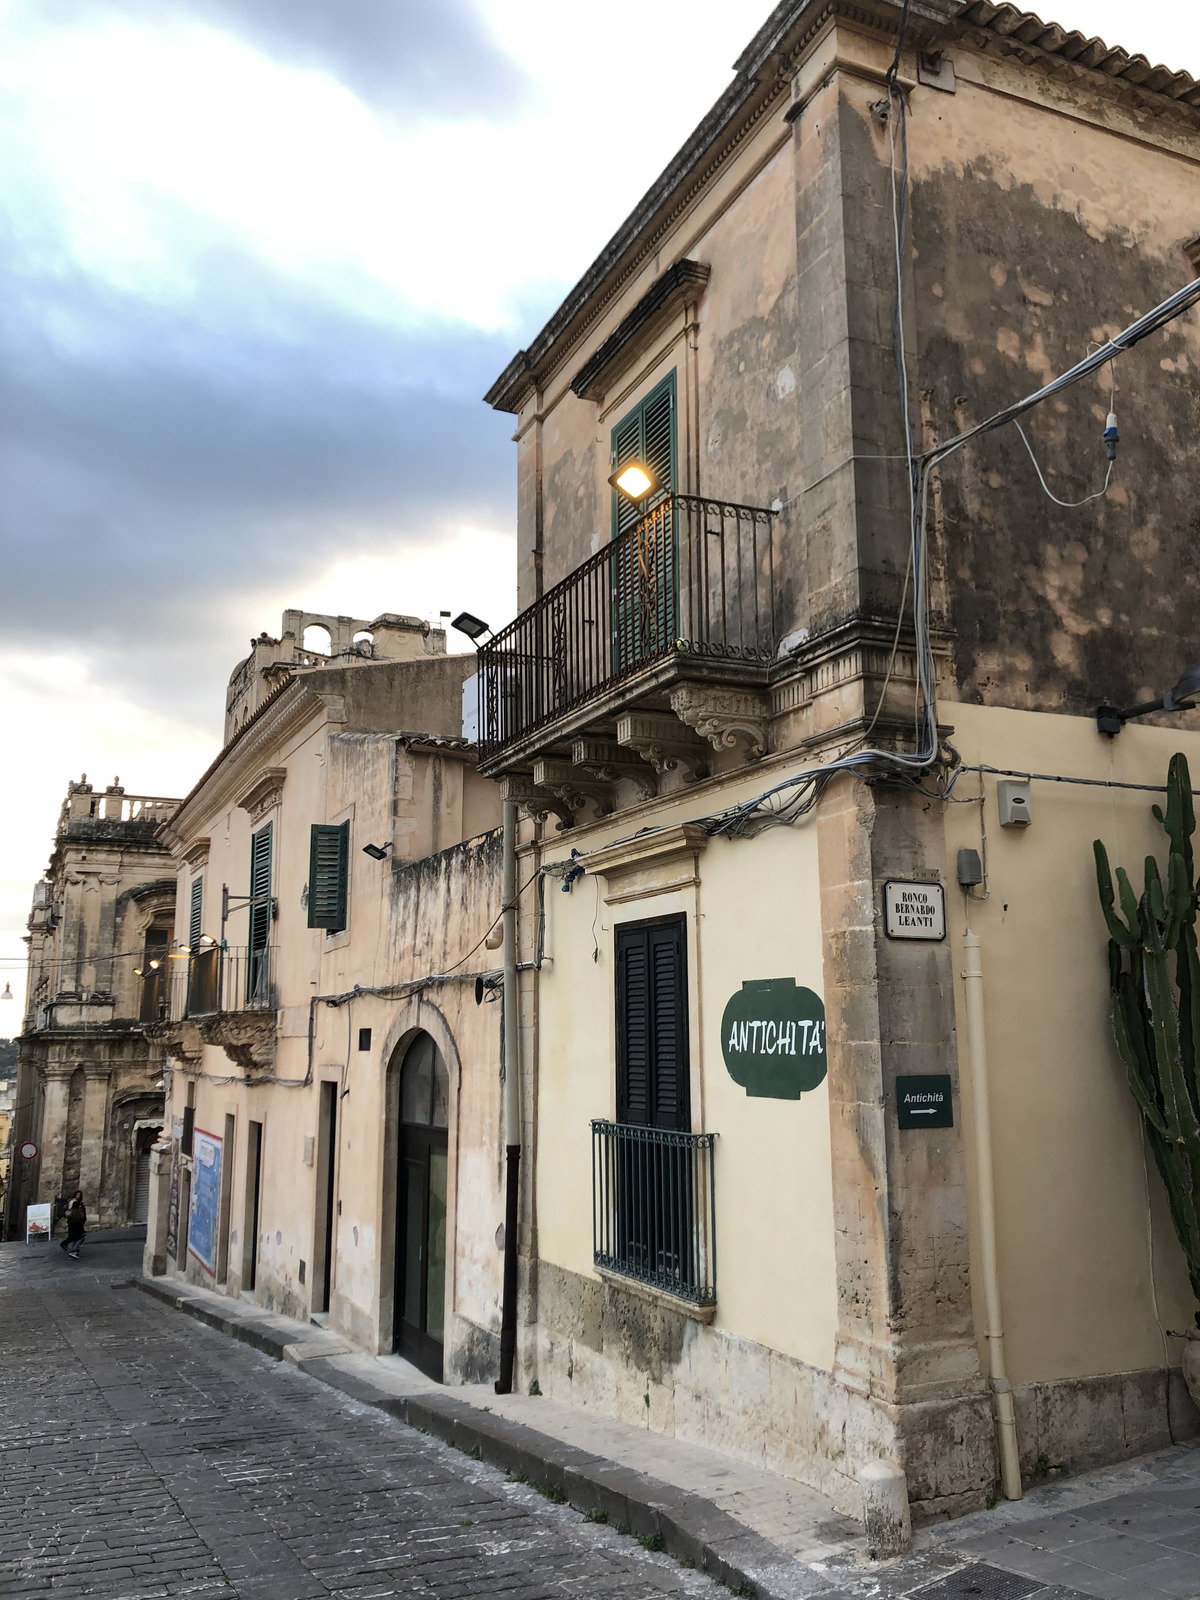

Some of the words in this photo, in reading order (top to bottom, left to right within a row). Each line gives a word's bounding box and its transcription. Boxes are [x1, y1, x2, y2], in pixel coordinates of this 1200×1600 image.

[902, 892, 928, 904] RONCO
[895, 903, 936, 915] BERNARDO
[898, 915, 933, 928] LEANTI
